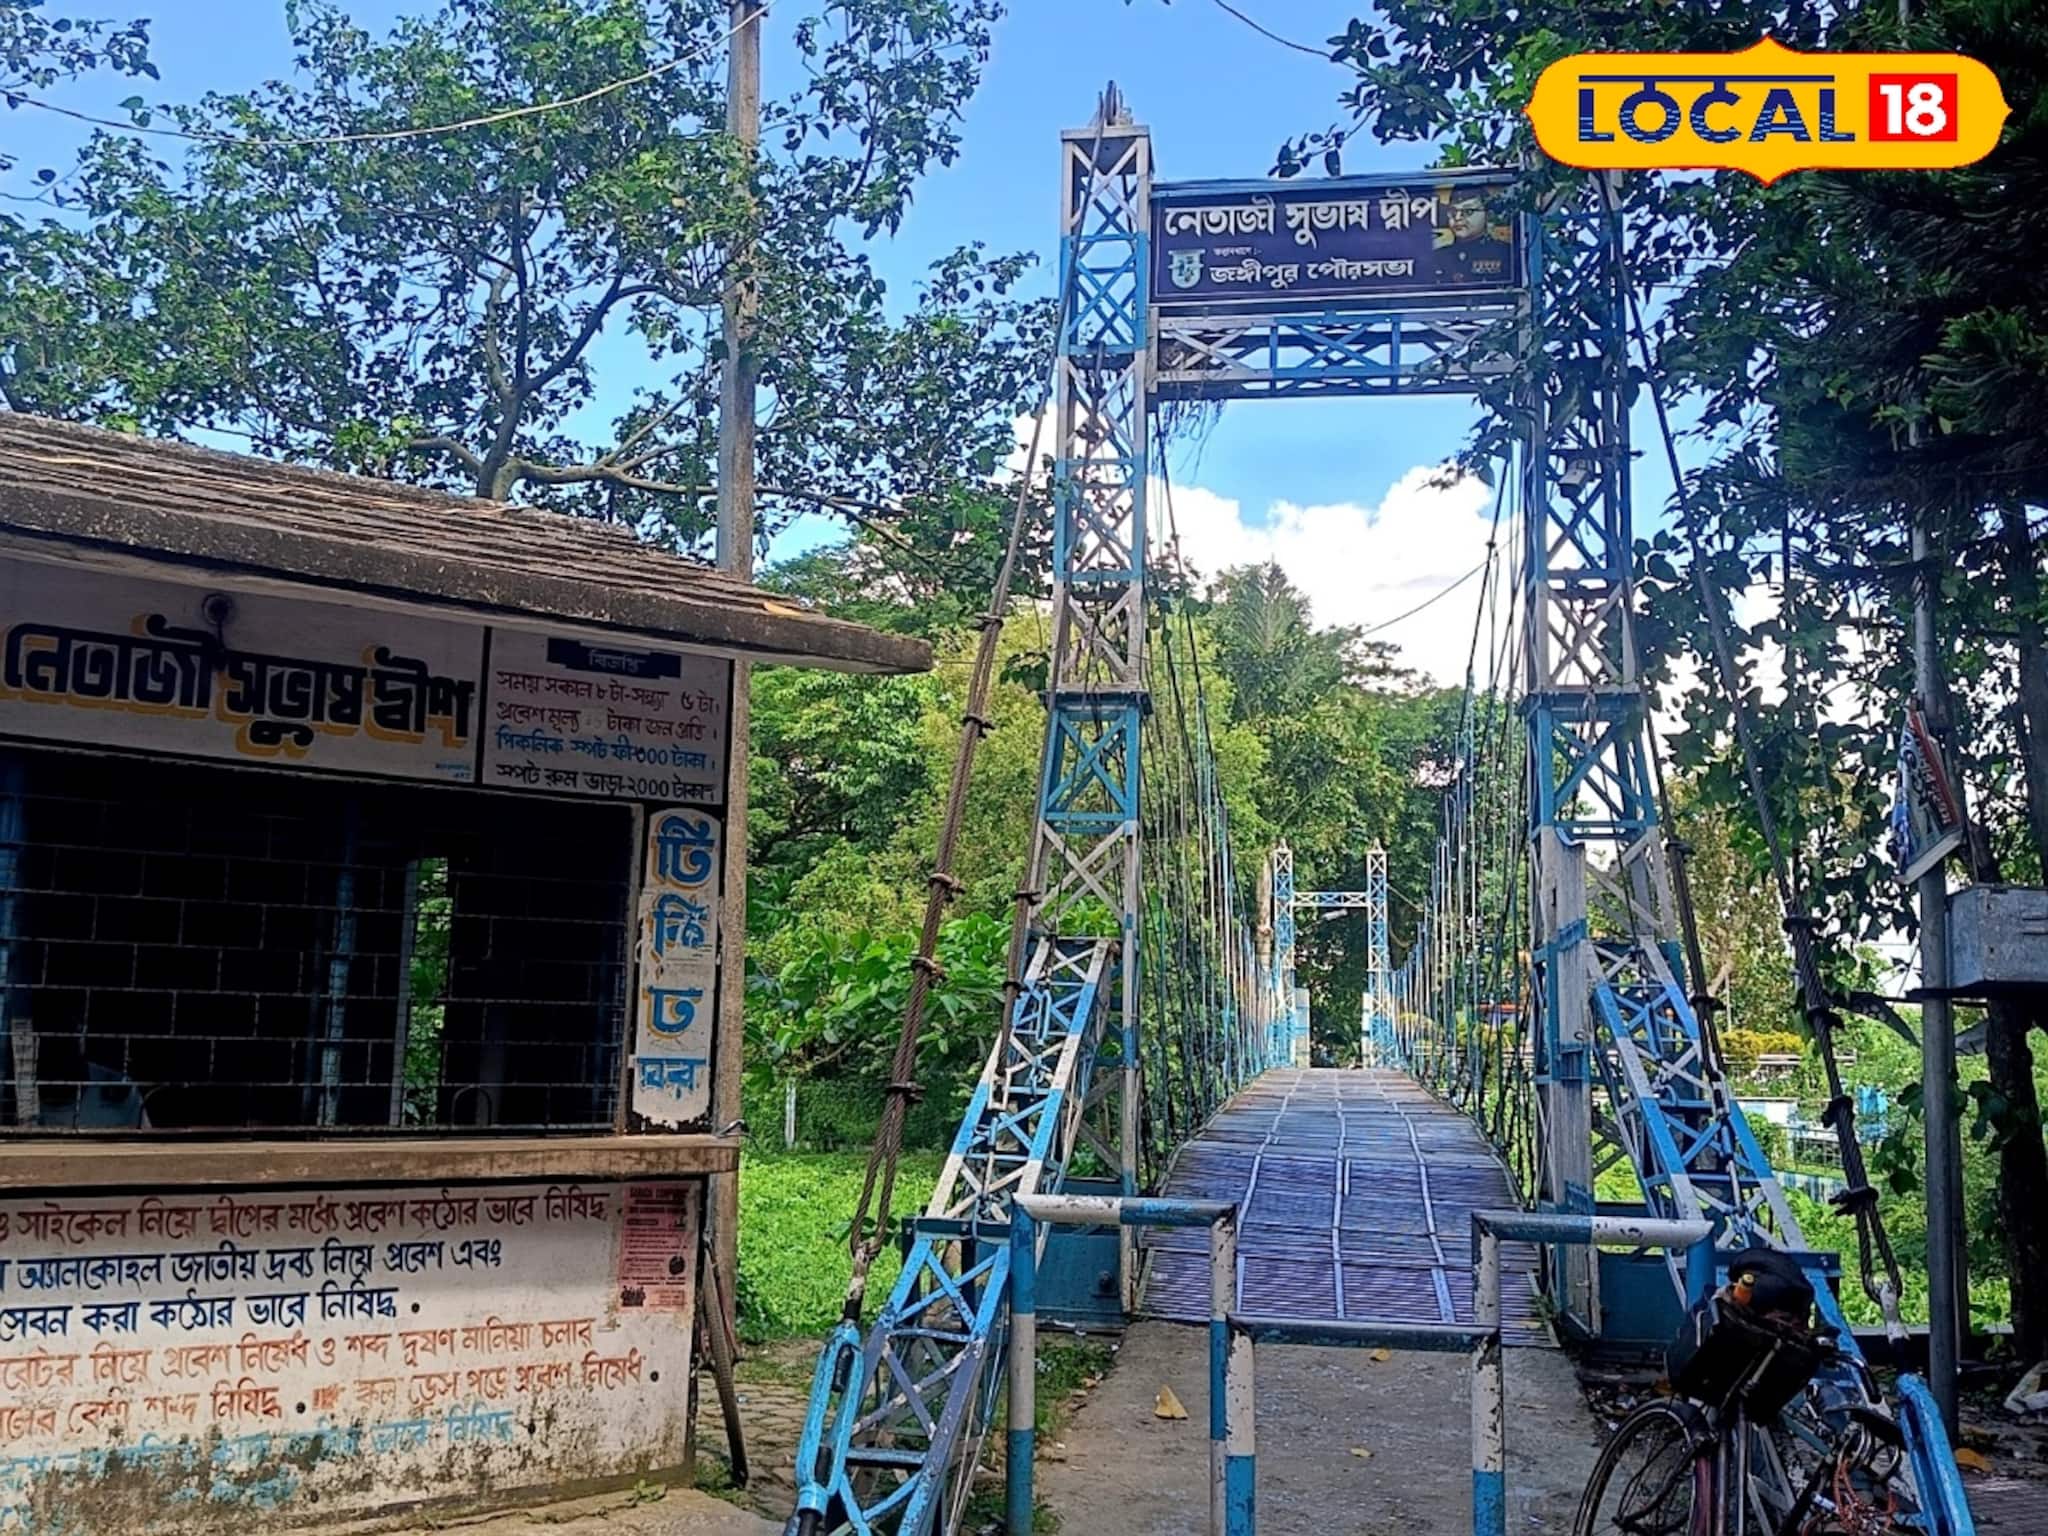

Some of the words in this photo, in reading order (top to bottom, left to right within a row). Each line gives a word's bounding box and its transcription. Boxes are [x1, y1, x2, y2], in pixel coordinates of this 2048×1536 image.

[1165, 193, 1275, 238] নেতাজী
[1285, 199, 1369, 249] সুভাষ
[1379, 187, 1439, 231] দ্বীপ
[1209, 258, 1299, 289] জঙ্গীপুর
[1306, 256, 1415, 281] পৌরসভা
[3, 613, 222, 712] নেতাজী
[364, 645, 476, 740] দ্বীপ
[496, 671, 543, 693] সময়
[543, 677, 592, 700] সকাল
[496, 702, 545, 725] প্রবেশ
[546, 707, 581, 734] মূল্য
[607, 708, 643, 733] টাকা
[644, 717, 673, 738] জন
[496, 724, 564, 756] পিকনিক
[671, 744, 707, 770] টাকা
[18, 1202, 132, 1245] সাইকেল
[138, 1196, 202, 1239] নিয়ে
[206, 1195, 286, 1235] দ্বীপের
[344, 1198, 405, 1233] প্রবেশ
[410, 1188, 480, 1233] কঠোর
[484, 1194, 539, 1226] ভাবে
[545, 1184, 611, 1222] নিষিদ্ধ
[17, 1252, 165, 1293] অ্যালকোহল
[171, 1240, 261, 1285] জাতীয়
[263, 1248, 315, 1281] দ্রব্য
[320, 1236, 375, 1274] নিয়ে
[383, 1239, 445, 1272] প্রবেশ
[451, 1239, 502, 1268] এবং
[0, 1305, 73, 1341] সেবন
[81, 1301, 140, 1335] করা
[150, 1288, 236, 1331] কঠোর
[245, 1291, 310, 1328] ভাবে
[317, 1279, 399, 1320] নিষিদ্ধ
[89, 1340, 152, 1383] নিয়ে
[161, 1343, 232, 1378] প্রবেশ
[314, 1336, 336, 1368] ও
[345, 1332, 392, 1362] শব্দ
[400, 1328, 457, 1367] দূষণ
[462, 1315, 534, 1352] মানিয়া
[539, 1318, 597, 1348] চলার
[210, 1377, 282, 1421] নিষিদ্ধ
[516, 1360, 573, 1395] প্রবেশ
[581, 1348, 643, 1391] নিষেধ
